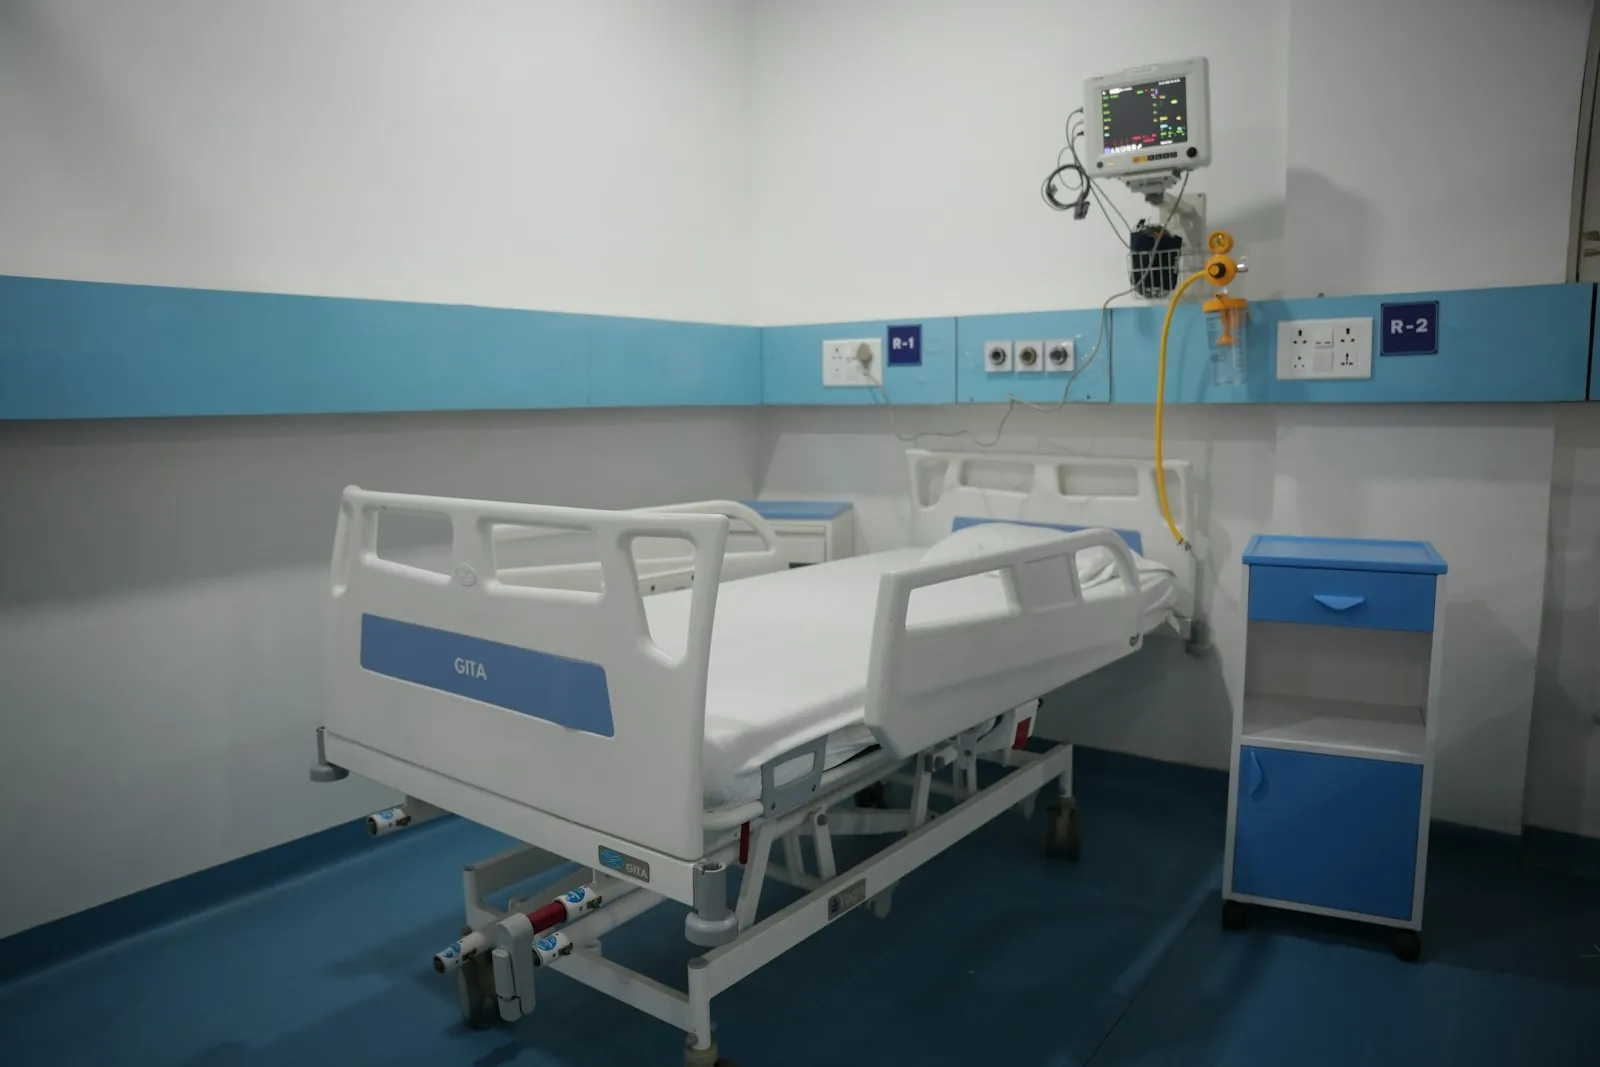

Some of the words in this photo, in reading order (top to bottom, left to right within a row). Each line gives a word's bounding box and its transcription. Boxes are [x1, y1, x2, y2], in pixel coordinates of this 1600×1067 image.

[1390, 317, 1429, 335] R-2
[892, 336, 914, 349] R-1
[454, 657, 488, 681] GITA
[626, 864, 648, 879] GITA
